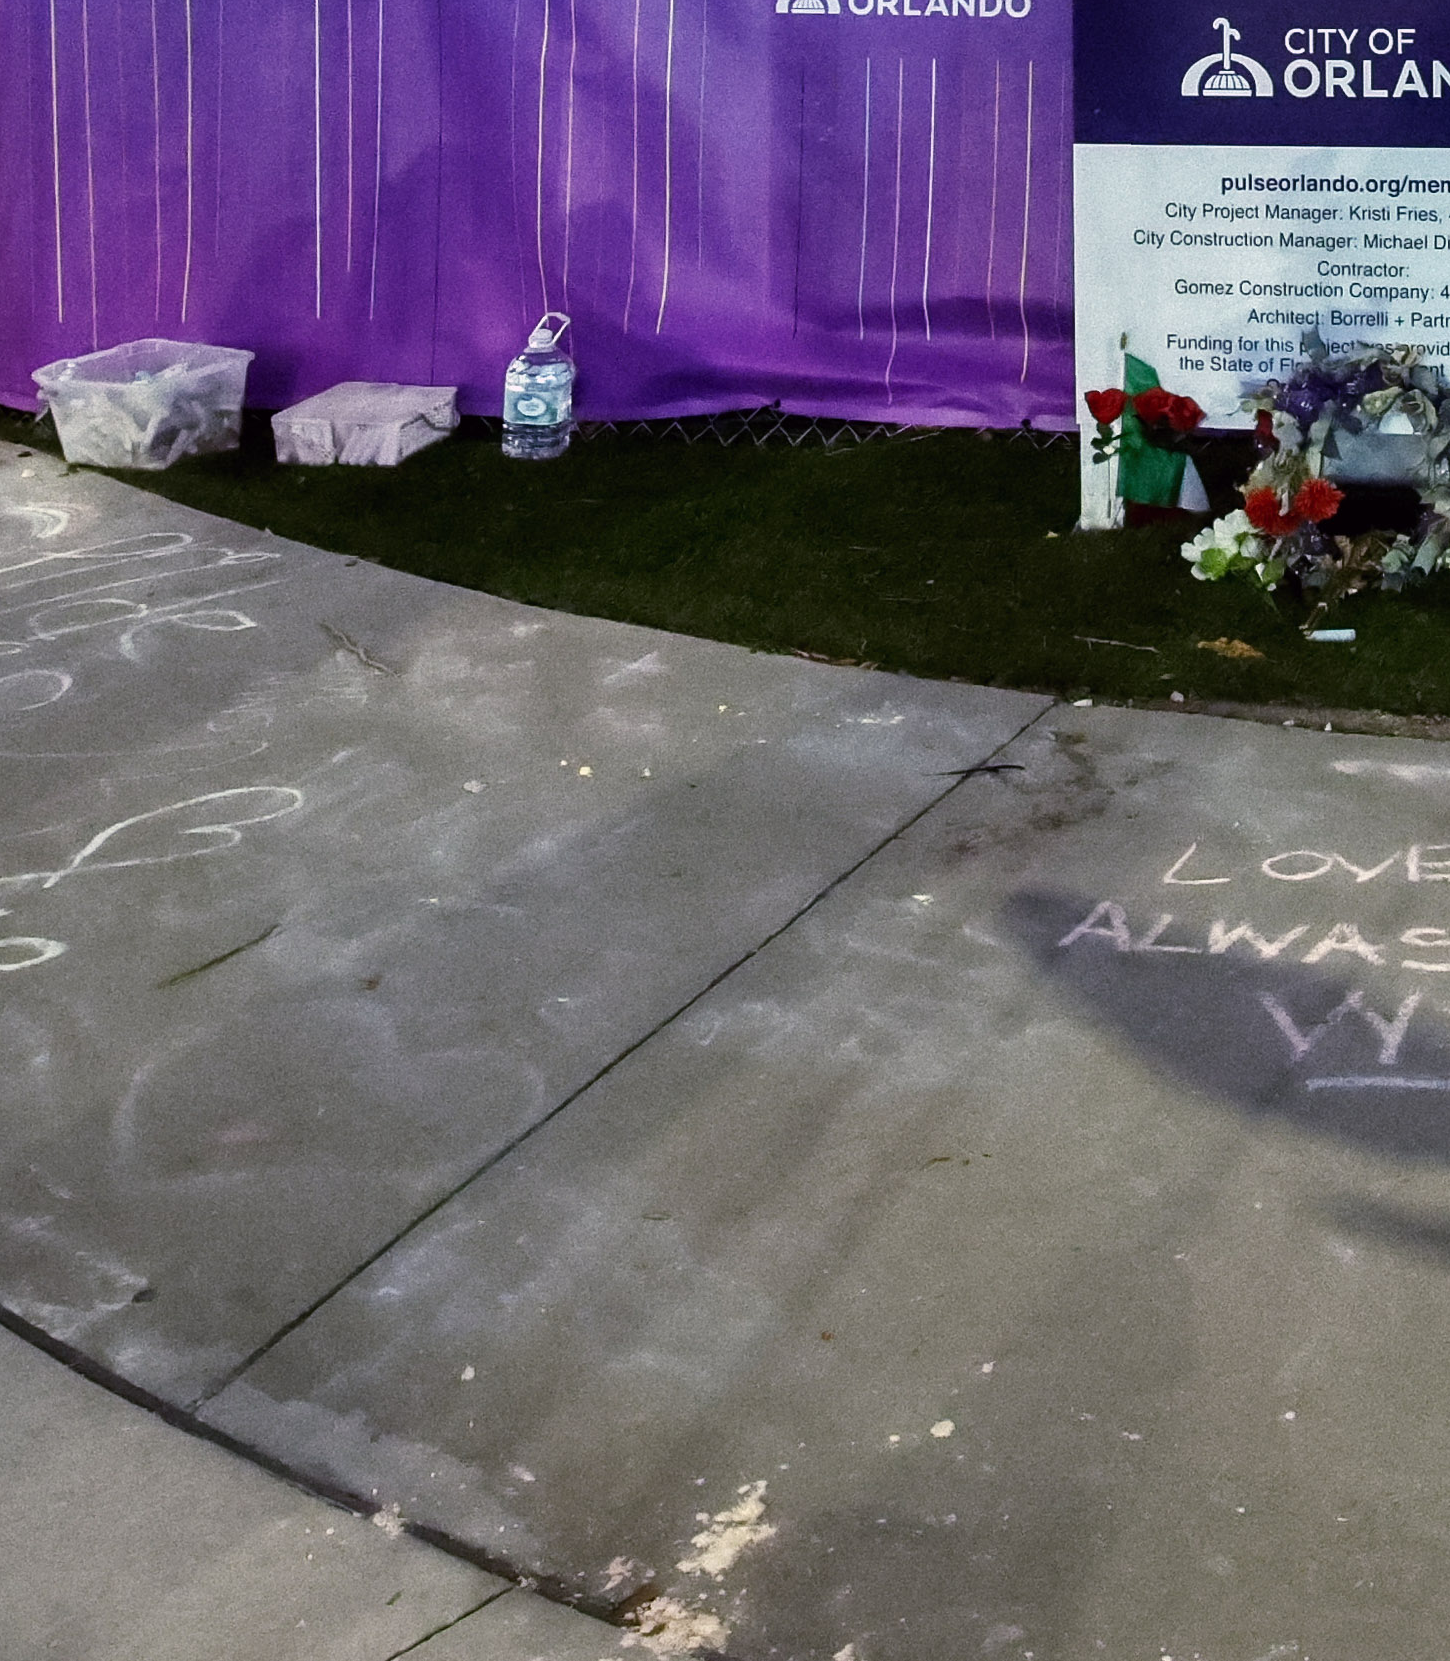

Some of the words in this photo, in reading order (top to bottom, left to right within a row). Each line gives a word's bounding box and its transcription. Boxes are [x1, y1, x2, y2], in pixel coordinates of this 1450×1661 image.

[1285, 29, 1358, 54] CITY
[1369, 29, 1415, 54] OF
[1166, 203, 1196, 221] City
[1203, 203, 1259, 222] Project
[1266, 205, 1343, 223] Manager:
[1350, 206, 1390, 221] Kristi
[1397, 206, 1441, 223] Fries,
[1134, 230, 1164, 249] City
[1170, 230, 1273, 247] Construction
[1280, 233, 1357, 252] Manager:
[1364, 234, 1427, 249] Michael
[1317, 261, 1410, 277] Contractor:
[1175, 279, 1233, 295] Gomez
[1240, 280, 1343, 297] Construction
[1349, 282, 1435, 303] Company:
[1247, 309, 1324, 326] Architect:
[1331, 310, 1388, 326] Borrelli
[1166, 335, 1232, 354] Funding
[1238, 336, 1260, 352] for
[1265, 336, 1294, 353] this
[1179, 356, 1204, 371] the
[1210, 357, 1253, 373] State
[1258, 357, 1274, 373] of
